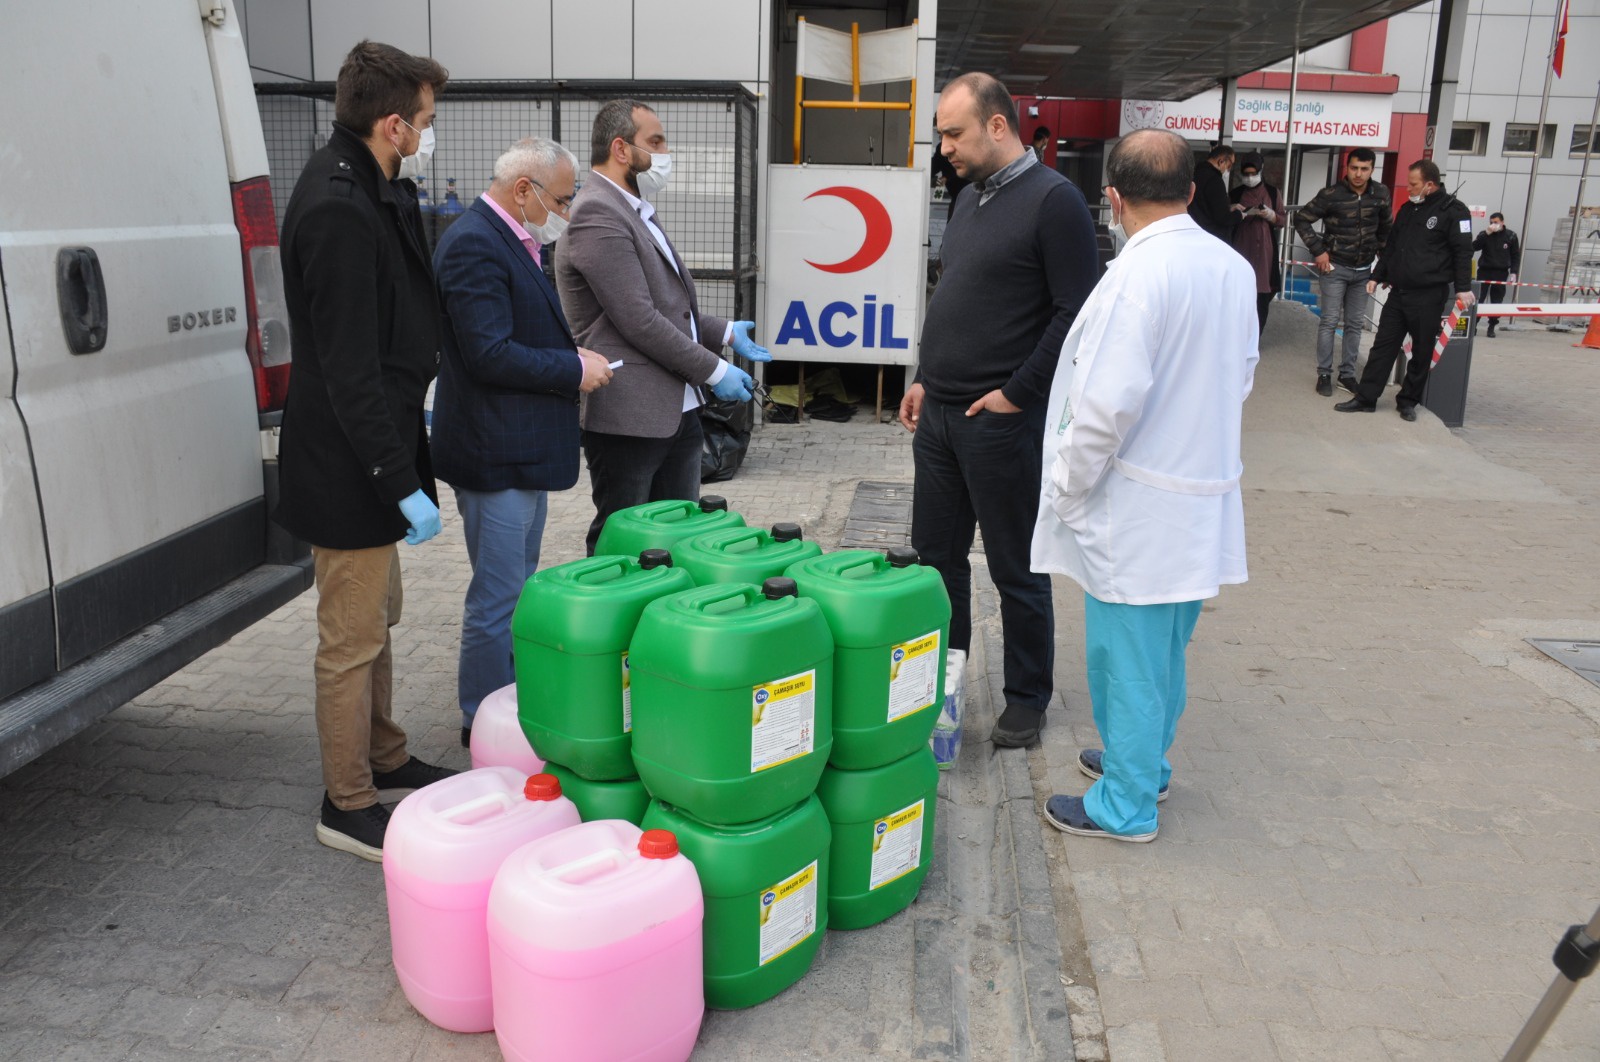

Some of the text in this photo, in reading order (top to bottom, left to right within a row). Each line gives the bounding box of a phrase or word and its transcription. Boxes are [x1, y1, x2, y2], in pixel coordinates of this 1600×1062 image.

[1238, 99, 1325, 116] Sağlık Baanlığı
[1164, 114, 1248, 133] GÜMÜŞHNE
[1304, 121, 1380, 137] HASTANESİ
[167, 306, 237, 333] BOXER
[774, 294, 909, 349] ACİL
[773, 685, 794, 696] ÇAMAŞIR
